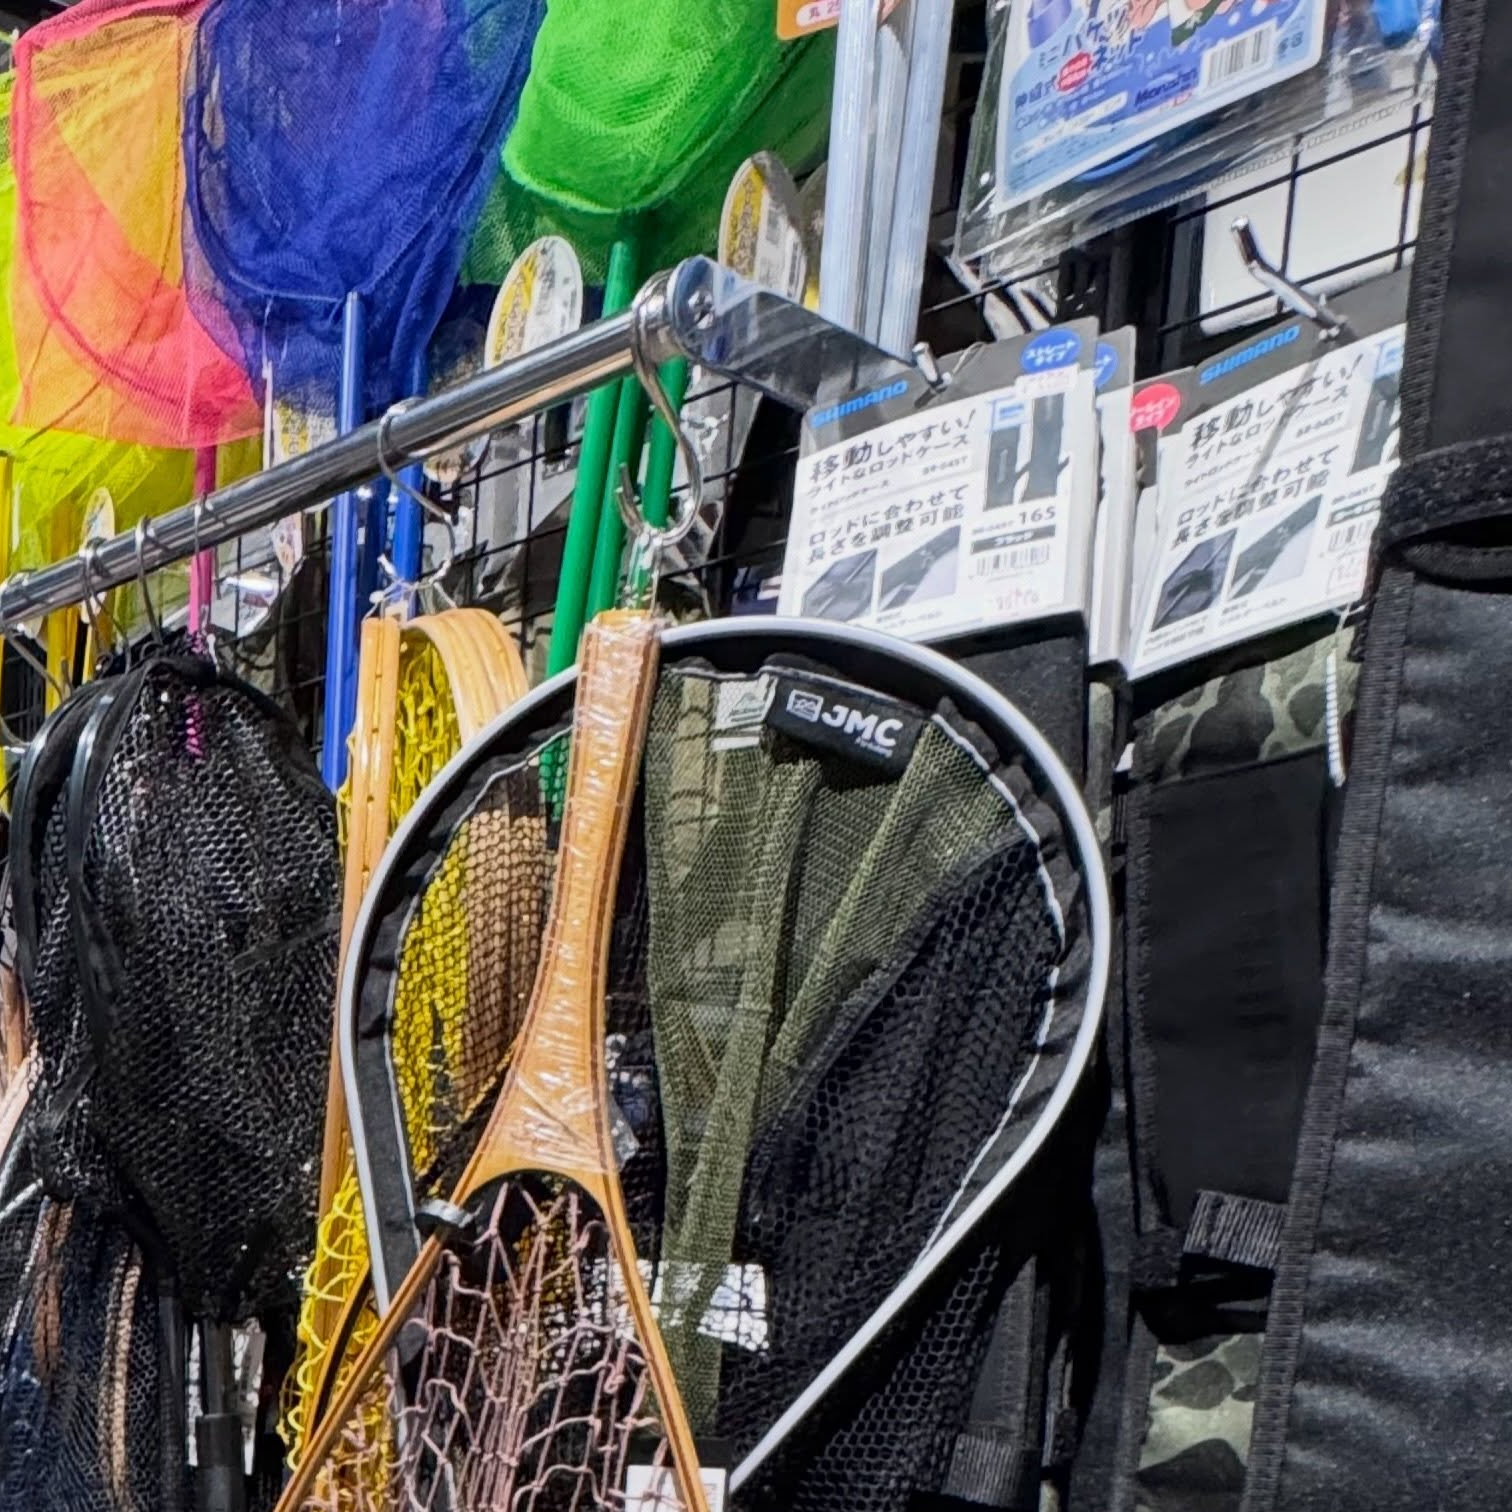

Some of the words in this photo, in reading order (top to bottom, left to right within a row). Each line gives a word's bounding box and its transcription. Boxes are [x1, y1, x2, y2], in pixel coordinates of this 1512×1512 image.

[1198, 324, 1301, 386] SHIMANO
[811, 379, 909, 429] SHIMANO
[1020, 506, 1057, 526] 165
[822, 704, 904, 747] JMC
